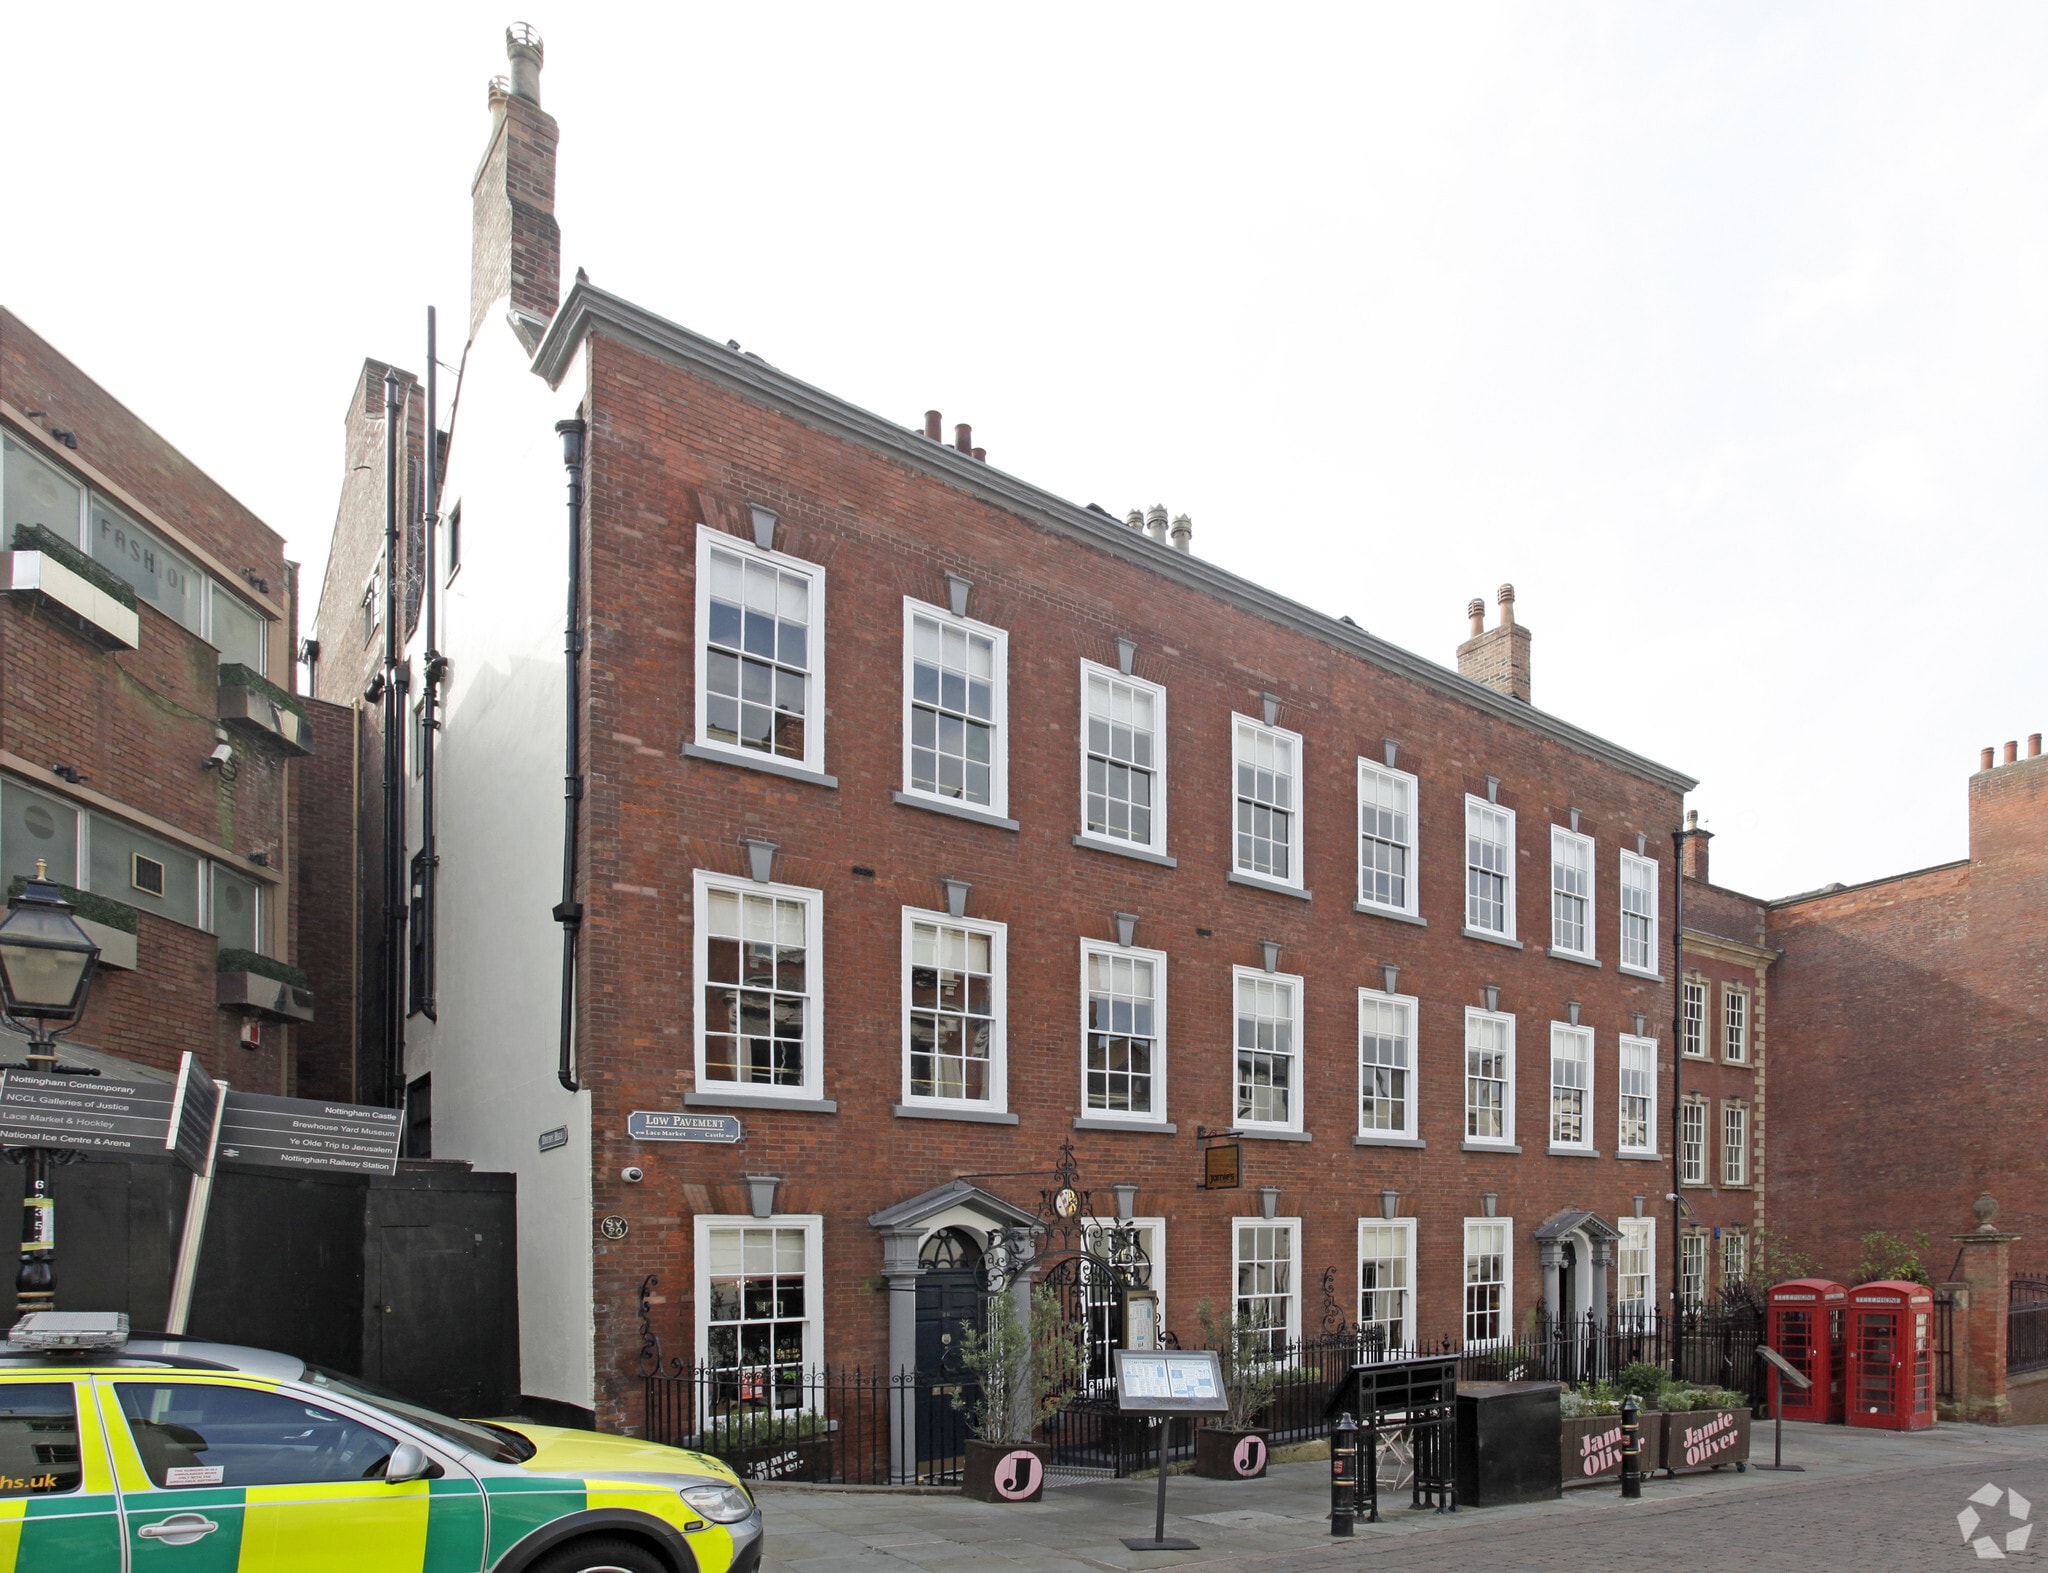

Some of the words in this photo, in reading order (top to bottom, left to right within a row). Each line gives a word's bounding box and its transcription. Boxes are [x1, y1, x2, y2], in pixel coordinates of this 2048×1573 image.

[10, 1075, 67, 1087] Nottingham
[69, 1080, 136, 1095] Contemporary
[6, 1093, 37, 1103] NCCL
[39, 1096, 82, 1107] Galleries
[96, 1102, 130, 1111] Justice
[2, 1112, 27, 1120] Lace
[30, 1114, 64, 1124] Market
[66, 1117, 74, 1125] &
[76, 1118, 115, 1129] Hockley
[325, 1107, 370, 1118] Nottingham
[371, 1111, 397, 1121] Castle
[292, 1120, 339, 1132] Brewhouse
[340, 1125, 359, 1134] Yard
[361, 1127, 395, 1137] Museum
[0, 1130, 40, 1140] National
[42, 1133, 57, 1142] Ice
[60, 1135, 92, 1144] Centre
[102, 1138, 131, 1148] Arena
[289, 1137, 300, 1145] Ye
[302, 1138, 322, 1147] Olde
[324, 1141, 340, 1150] Trip
[341, 1142, 350, 1150] to
[351, 1144, 393, 1154] Jerusalem
[280, 1154, 328, 1165] Nottingham
[329, 1158, 361, 1169] Railway
[362, 1161, 390, 1170] Station
[1683, 1412, 1734, 1449] Jamie
[1580, 1426, 1622, 1457] Jam
[1686, 1429, 1738, 1466] Oliver
[747, 1450, 798, 1474] Jamie
[1238, 1441, 1261, 1471] J
[1583, 1437, 1645, 1477] Olivr
[1002, 1457, 1036, 1493] J
